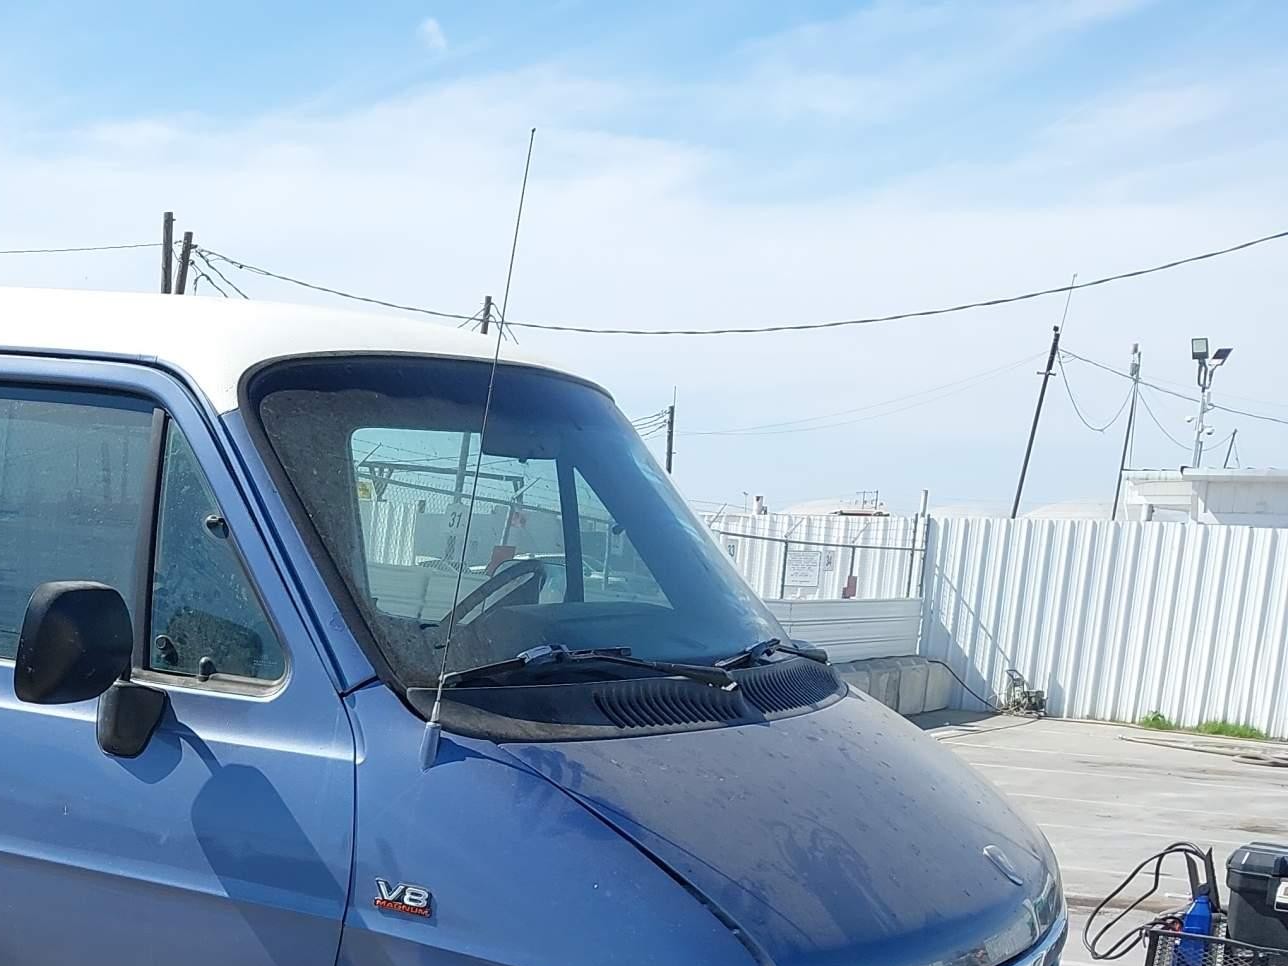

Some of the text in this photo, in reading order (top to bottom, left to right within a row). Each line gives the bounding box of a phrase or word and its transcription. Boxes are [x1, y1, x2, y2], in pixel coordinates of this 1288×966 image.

[448, 511, 463, 529] 31
[375, 878, 430, 908] V8
[375, 899, 430, 917] MAGNUM
